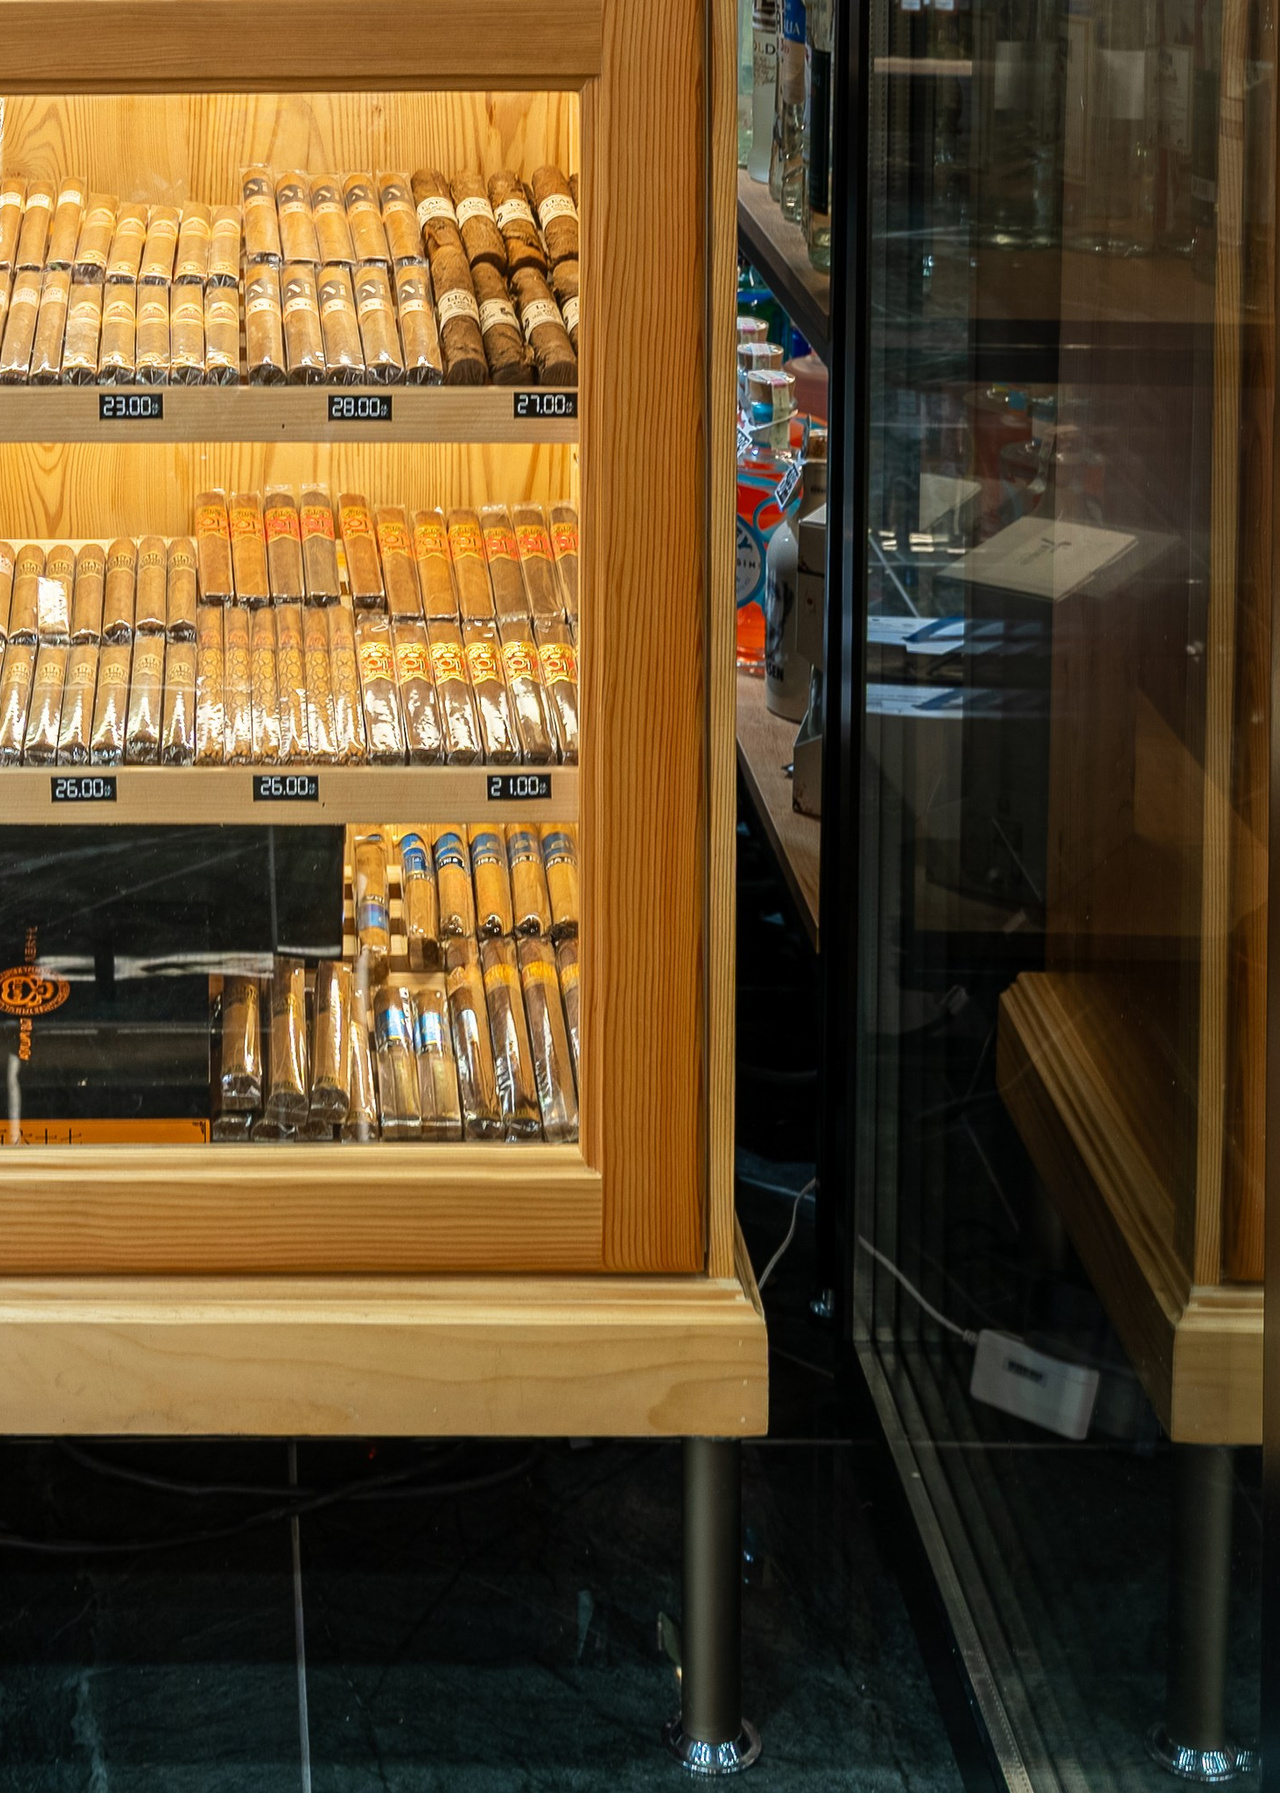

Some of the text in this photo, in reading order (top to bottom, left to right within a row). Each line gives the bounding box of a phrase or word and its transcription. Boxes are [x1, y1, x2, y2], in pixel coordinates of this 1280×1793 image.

[104, 397, 150, 416] 23.00
[332, 397, 379, 417] 28.00
[518, 395, 565, 415] 27.00
[56, 780, 103, 799] 26.00
[261, 776, 308, 796] 26.00
